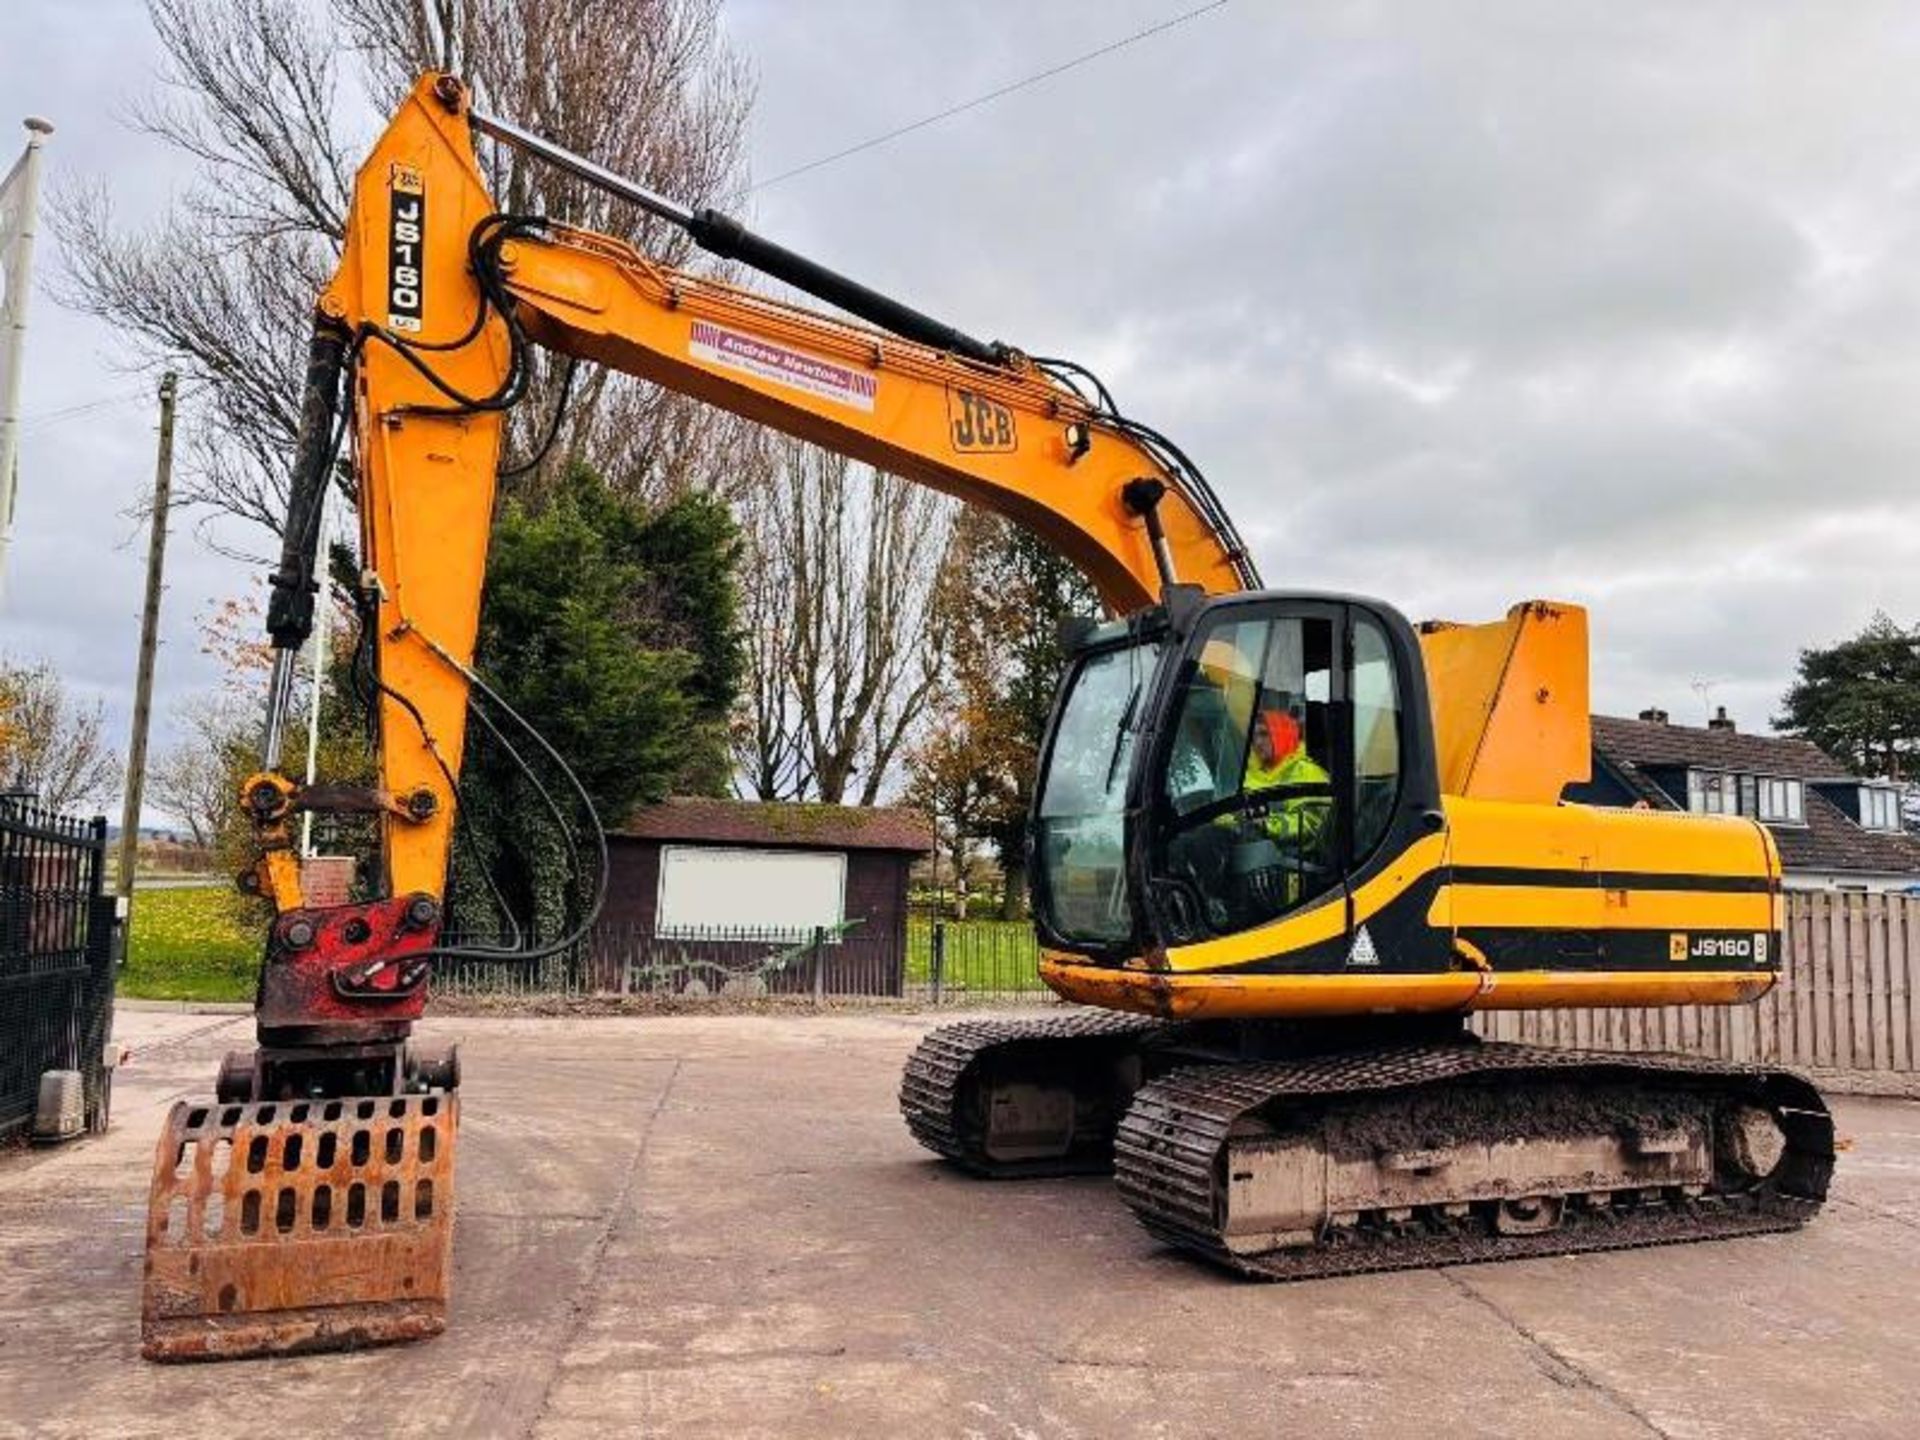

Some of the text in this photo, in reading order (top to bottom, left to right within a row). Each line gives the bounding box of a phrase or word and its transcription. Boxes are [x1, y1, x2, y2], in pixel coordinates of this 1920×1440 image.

[394, 201, 421, 309] JS160
[722, 338, 781, 365] Andrew
[784, 353, 839, 383] Newton
[956, 389, 1011, 447] JCB
[1691, 938, 1750, 956] JS160
